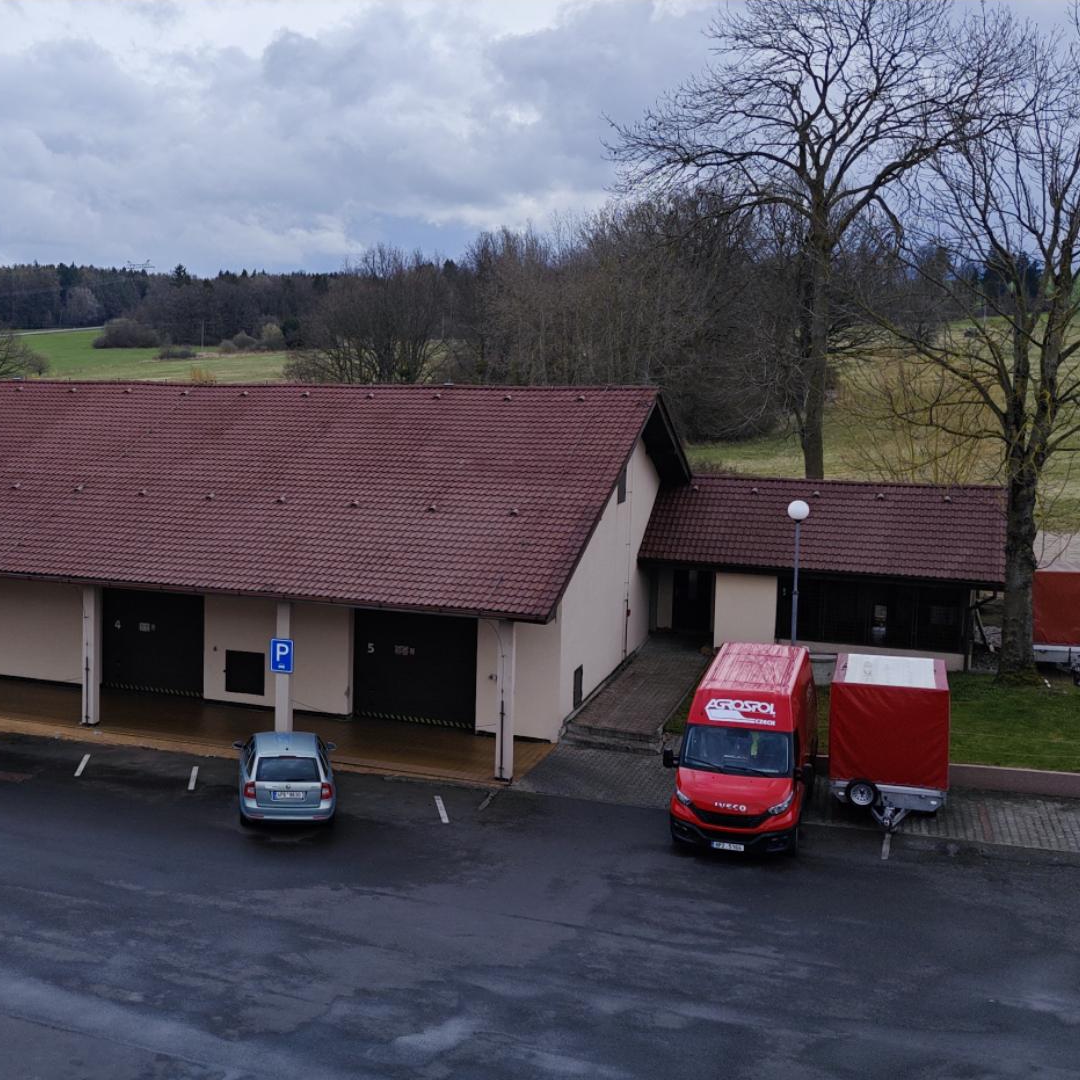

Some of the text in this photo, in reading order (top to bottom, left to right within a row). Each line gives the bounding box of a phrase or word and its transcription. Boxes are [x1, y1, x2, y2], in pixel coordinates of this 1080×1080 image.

[276, 643, 289, 662] P
[367, 642, 375, 653] 5
[704, 699, 776, 715] AGROSPOL
[714, 801, 747, 812] IVECO
